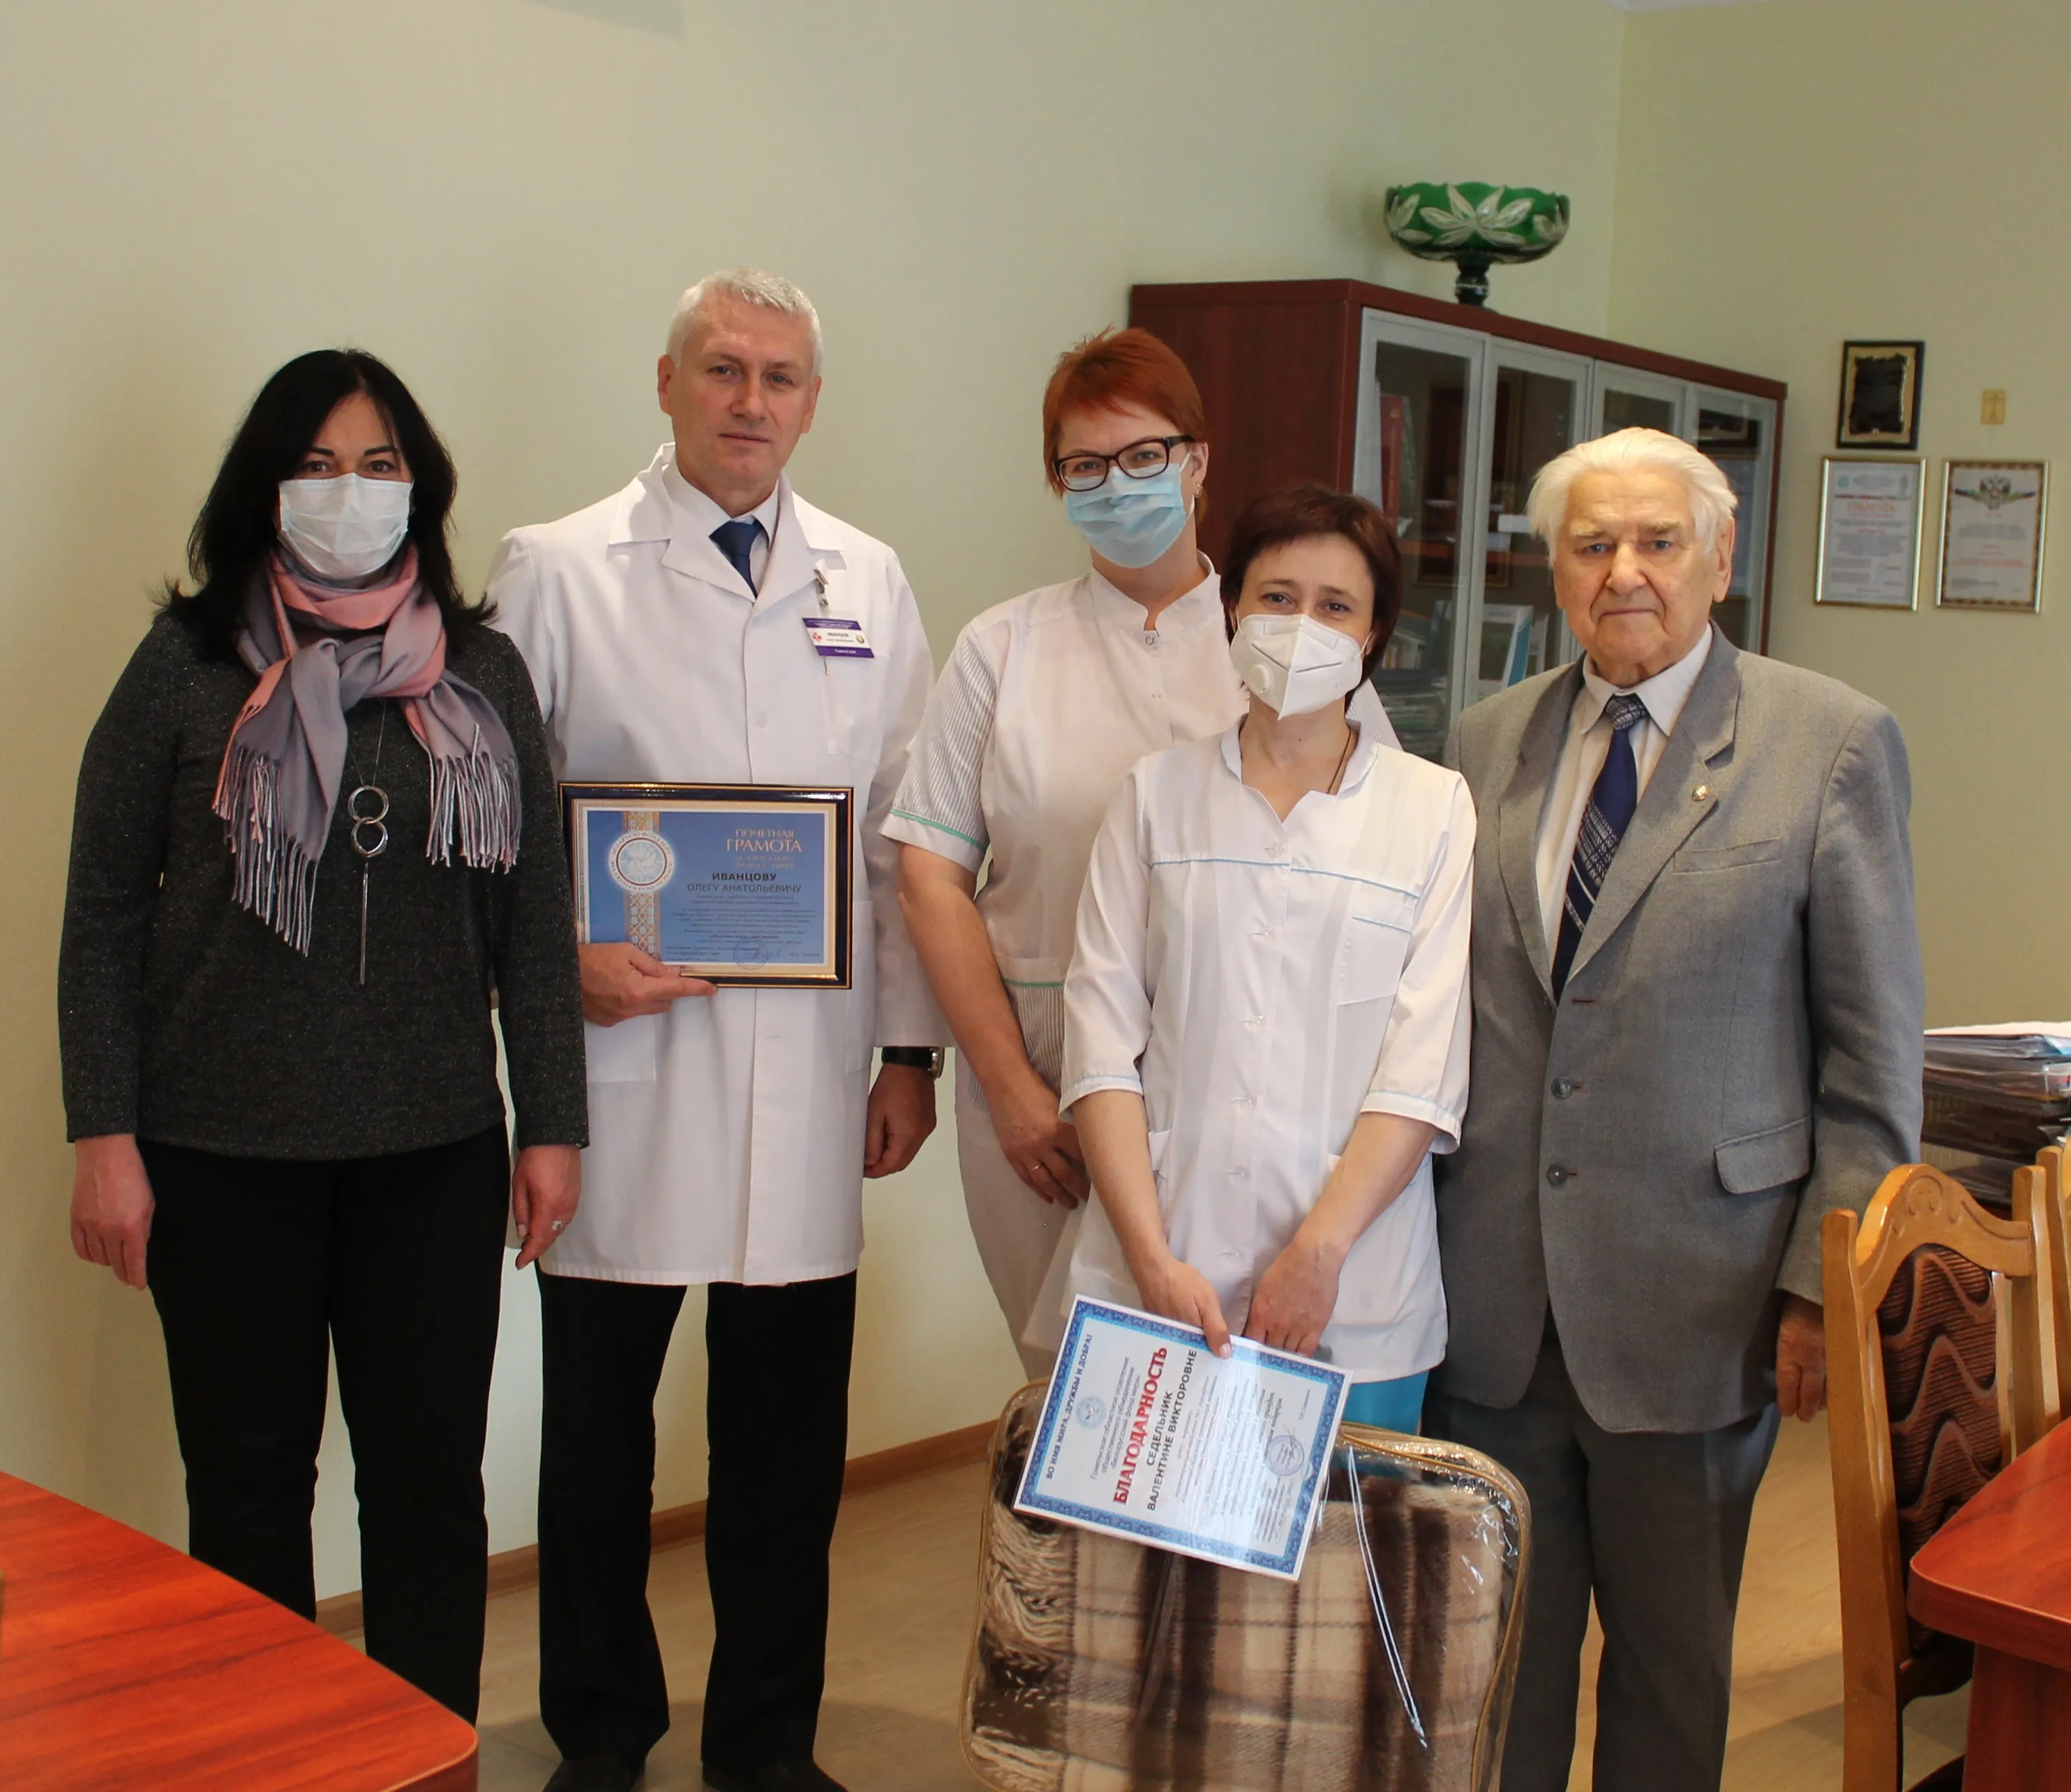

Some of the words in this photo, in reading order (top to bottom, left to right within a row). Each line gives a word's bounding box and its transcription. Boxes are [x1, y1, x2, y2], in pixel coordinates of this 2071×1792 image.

[726, 838, 802, 853] ГРАМОТА
[712, 872, 777, 883] ИВАНЦОВУ
[687, 883, 719, 893] ОЛЕГУ
[722, 883, 802, 893] АНАТОЛЬЕВИЧУ
[1064, 1376, 1080, 1415] ДРУЖБЫ
[1112, 1347, 1167, 1504] БЛАГОДАРНОСТЬ
[1146, 1390, 1173, 1466] СЕДЕЛЬНИК
[1146, 1435, 1174, 1511] ВАЛЕНТИНЕ
[1167, 1349, 1197, 1432] ВИКТОРОВНЕ
[1049, 1444, 1061, 1464] ИМЯ
[1045, 1465, 1054, 1479] ВО
